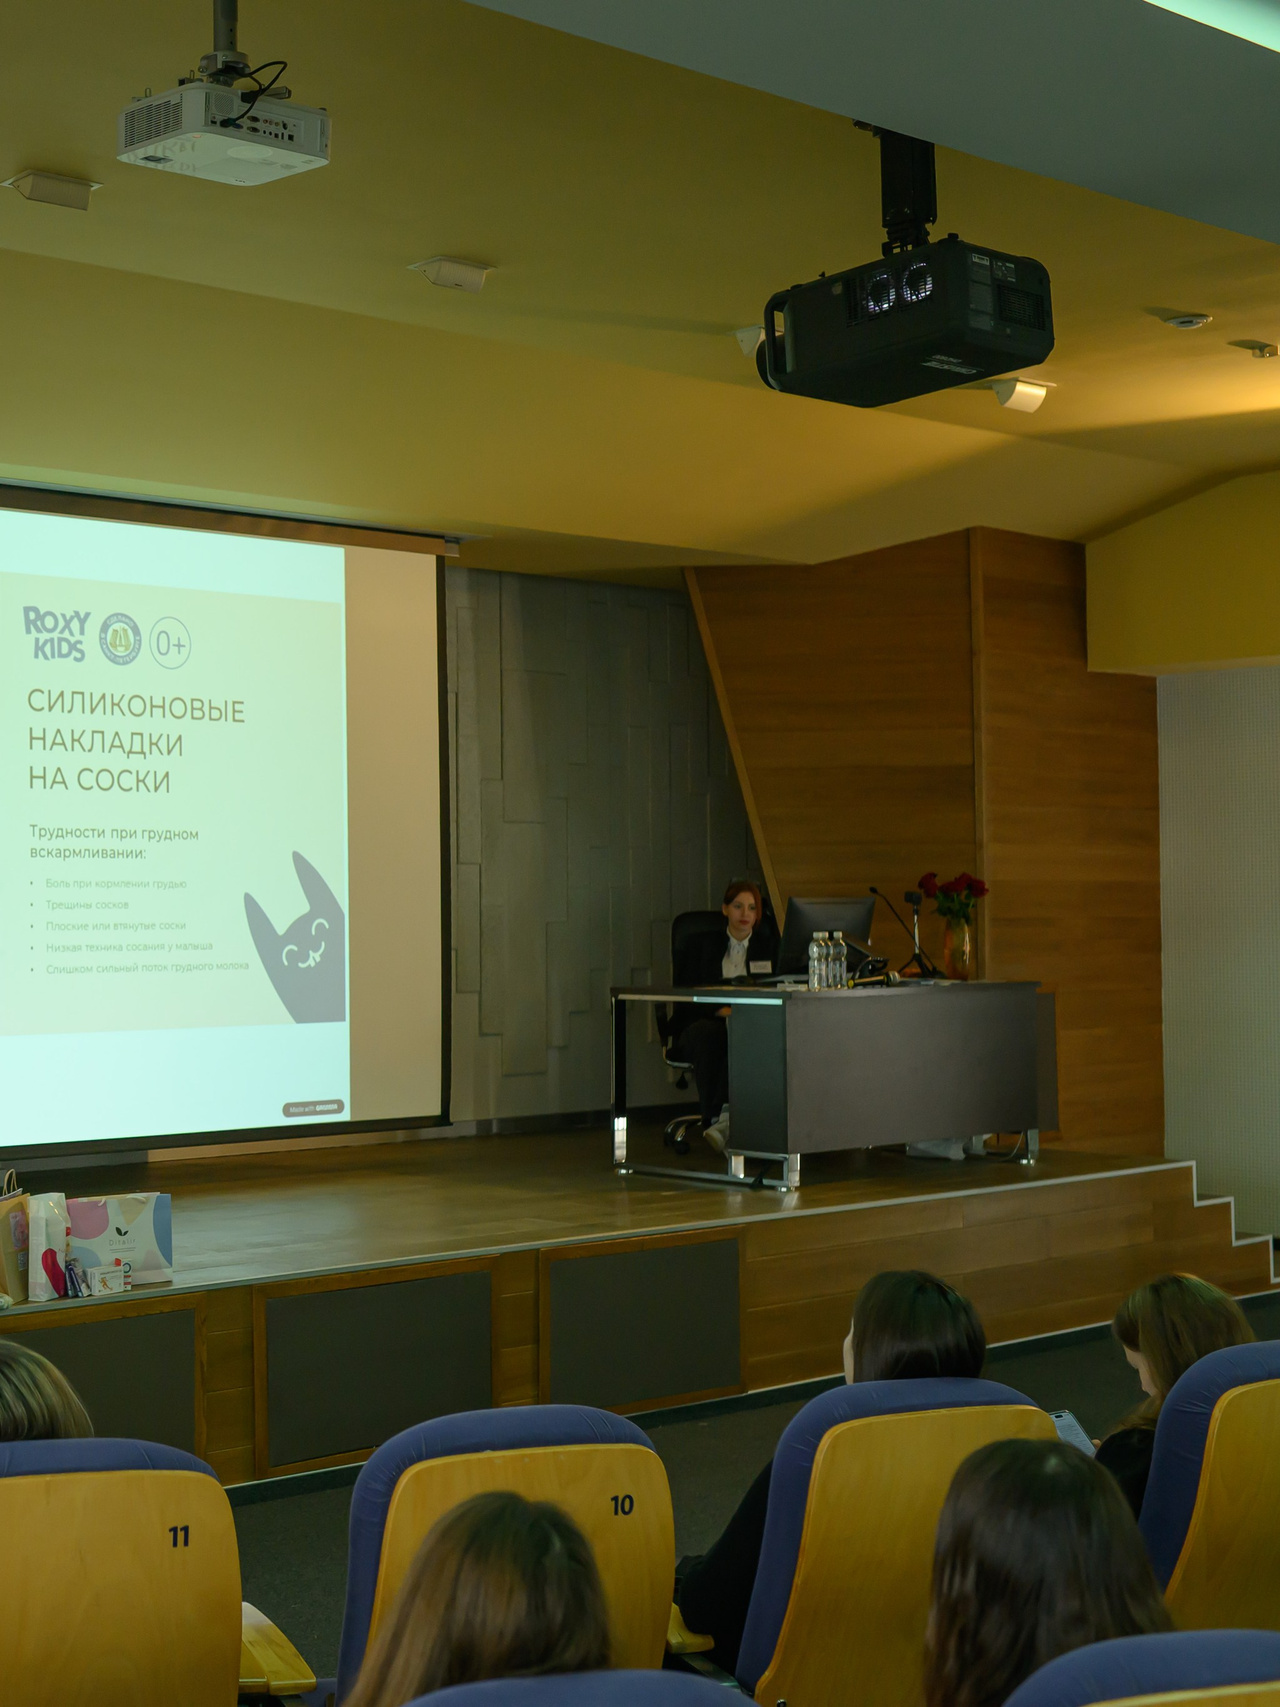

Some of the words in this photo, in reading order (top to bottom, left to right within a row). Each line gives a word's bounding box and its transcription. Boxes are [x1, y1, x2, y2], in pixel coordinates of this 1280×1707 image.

[23, 606, 91, 637] ROXY
[34, 637, 86, 662] KIDS
[156, 630, 186, 656] 0+
[28, 688, 245, 723] СИЛИКОНОВЫЕ
[29, 727, 183, 759] НАКЛАДКИ
[29, 765, 68, 790] НА
[77, 768, 170, 793] СОСКИ
[29, 824, 105, 840] Трудности
[111, 827, 137, 842] при
[141, 828, 199, 842] грудном
[29, 847, 146, 861] вскармливании:
[46, 878, 71, 888] Боль
[73, 879, 92, 890] при
[95, 879, 150, 890] кормлении
[152, 880, 187, 890] грудью
[46, 900, 92, 911] Трещины
[95, 901, 129, 910] сосков
[46, 921, 90, 932] Плоские
[92, 922, 111, 931] или
[113, 922, 157, 932] втянутые
[159, 921, 186, 930] соски
[46, 943, 83, 953] Низкая
[85, 943, 123, 952] техника
[125, 942, 166, 952] сосания
[168, 943, 173, 953] у
[175, 942, 214, 951] малыша
[46, 964, 93, 975] Слишком
[96, 962, 139, 973] сильный
[141, 963, 169, 973] поток
[171, 962, 214, 973] грудного
[216, 961, 249, 971] молока
[610, 1494, 634, 1516] 10
[169, 1525, 190, 1548] 11
